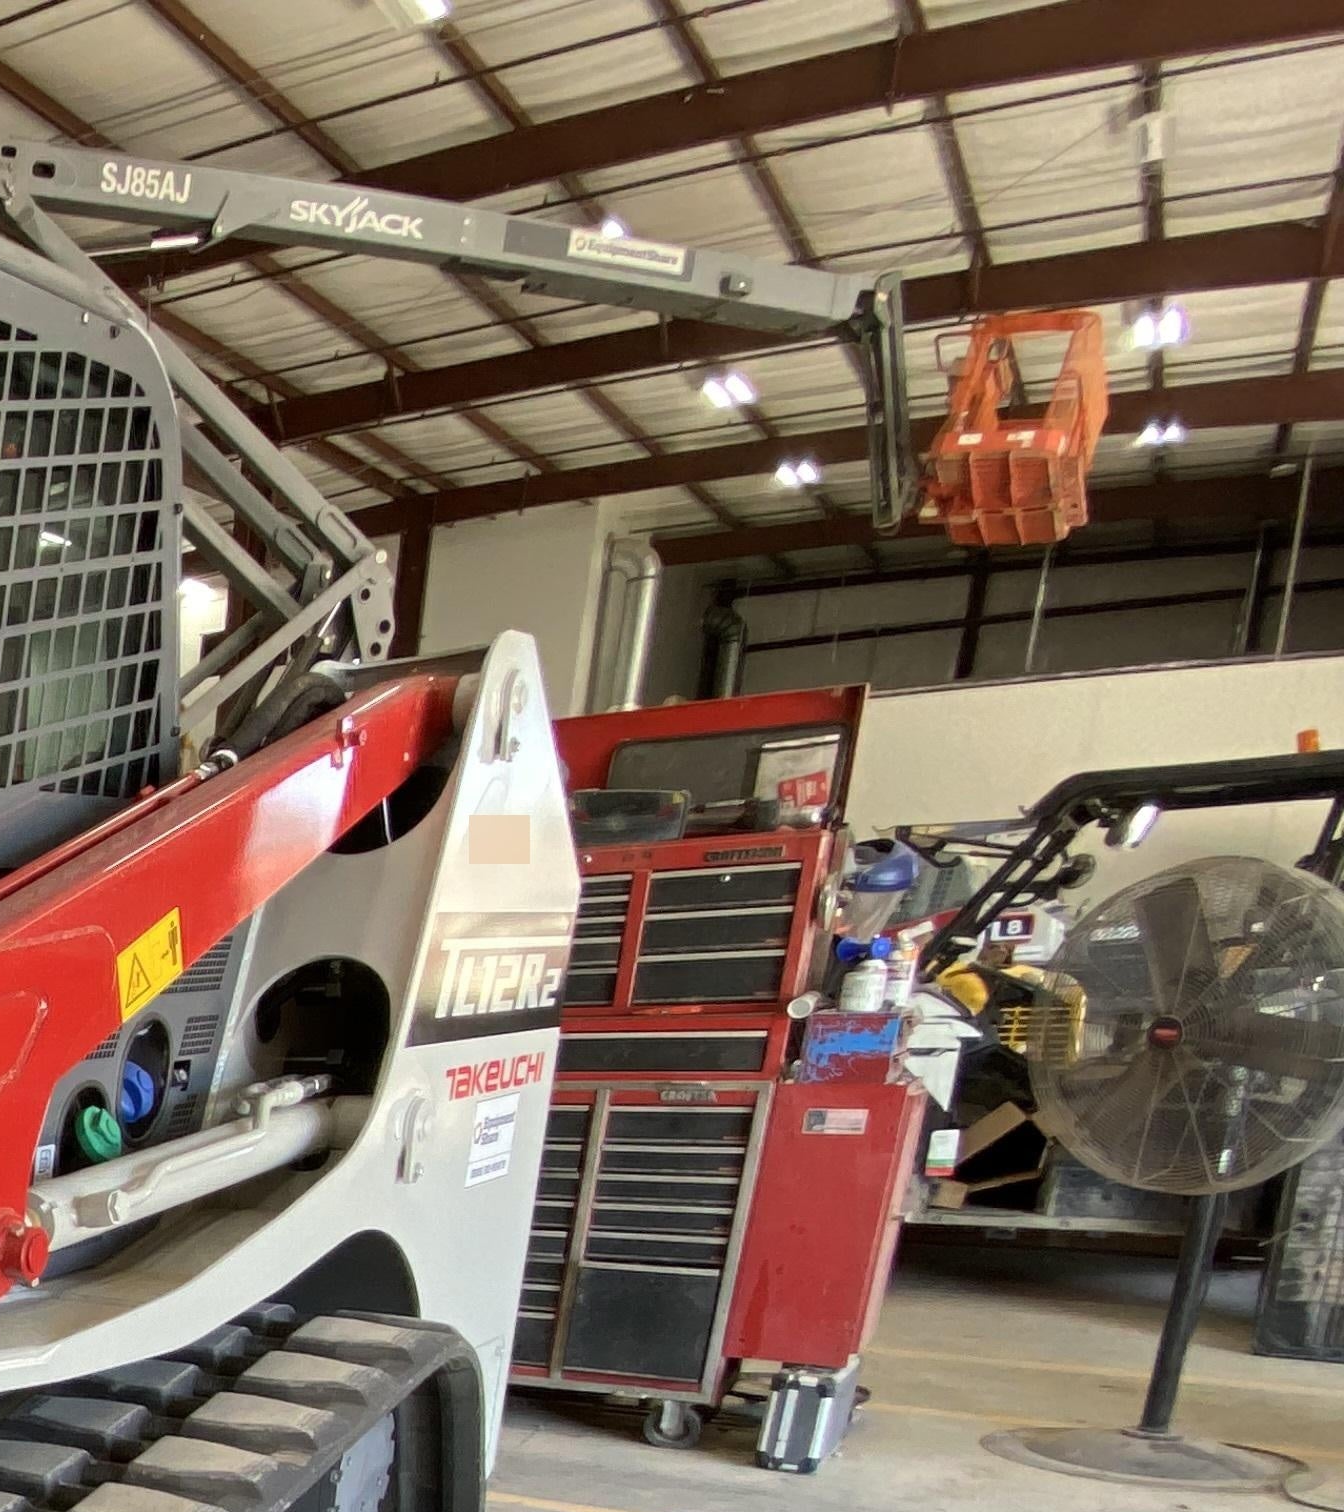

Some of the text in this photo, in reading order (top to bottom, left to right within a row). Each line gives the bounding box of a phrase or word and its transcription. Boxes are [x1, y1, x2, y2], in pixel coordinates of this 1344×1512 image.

[100, 162, 192, 204] SJ85AJ
[289, 196, 424, 240] SKYJACK
[446, 1051, 545, 1101] TAKEUCHI
